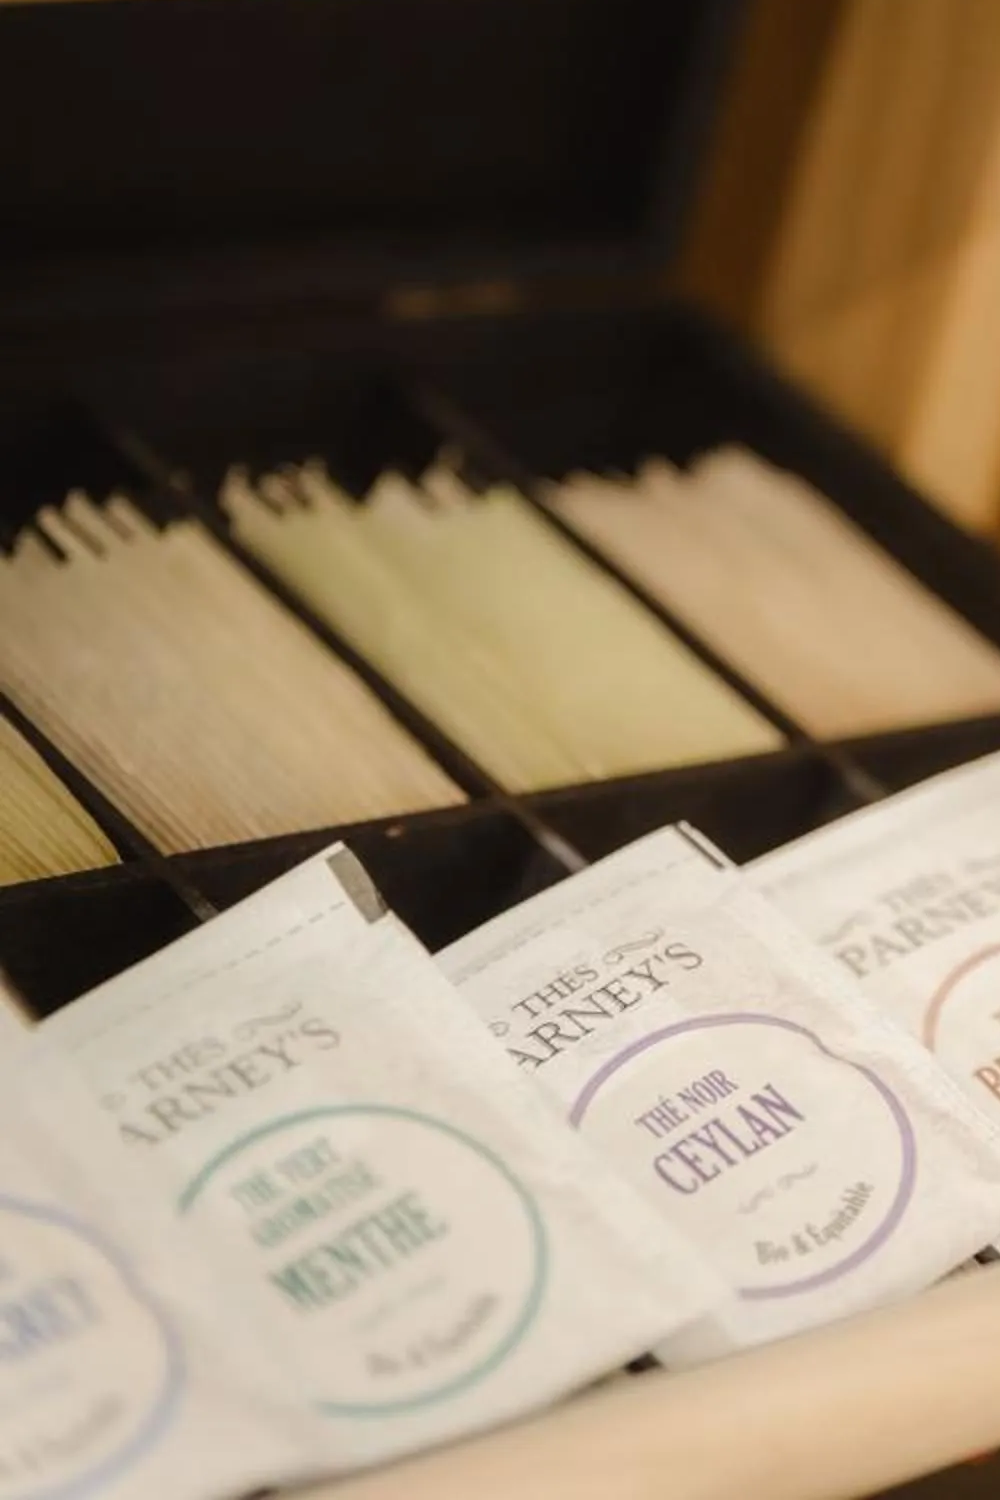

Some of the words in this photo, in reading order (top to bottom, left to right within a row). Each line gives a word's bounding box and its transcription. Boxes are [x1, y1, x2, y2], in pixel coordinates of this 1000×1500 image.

[505, 942, 703, 1069] ARNEY'S
[118, 1017, 341, 1145] ARNEY'S
[653, 1082, 806, 1195] CEYLAN
[677, 1069, 740, 1113] NOIR
